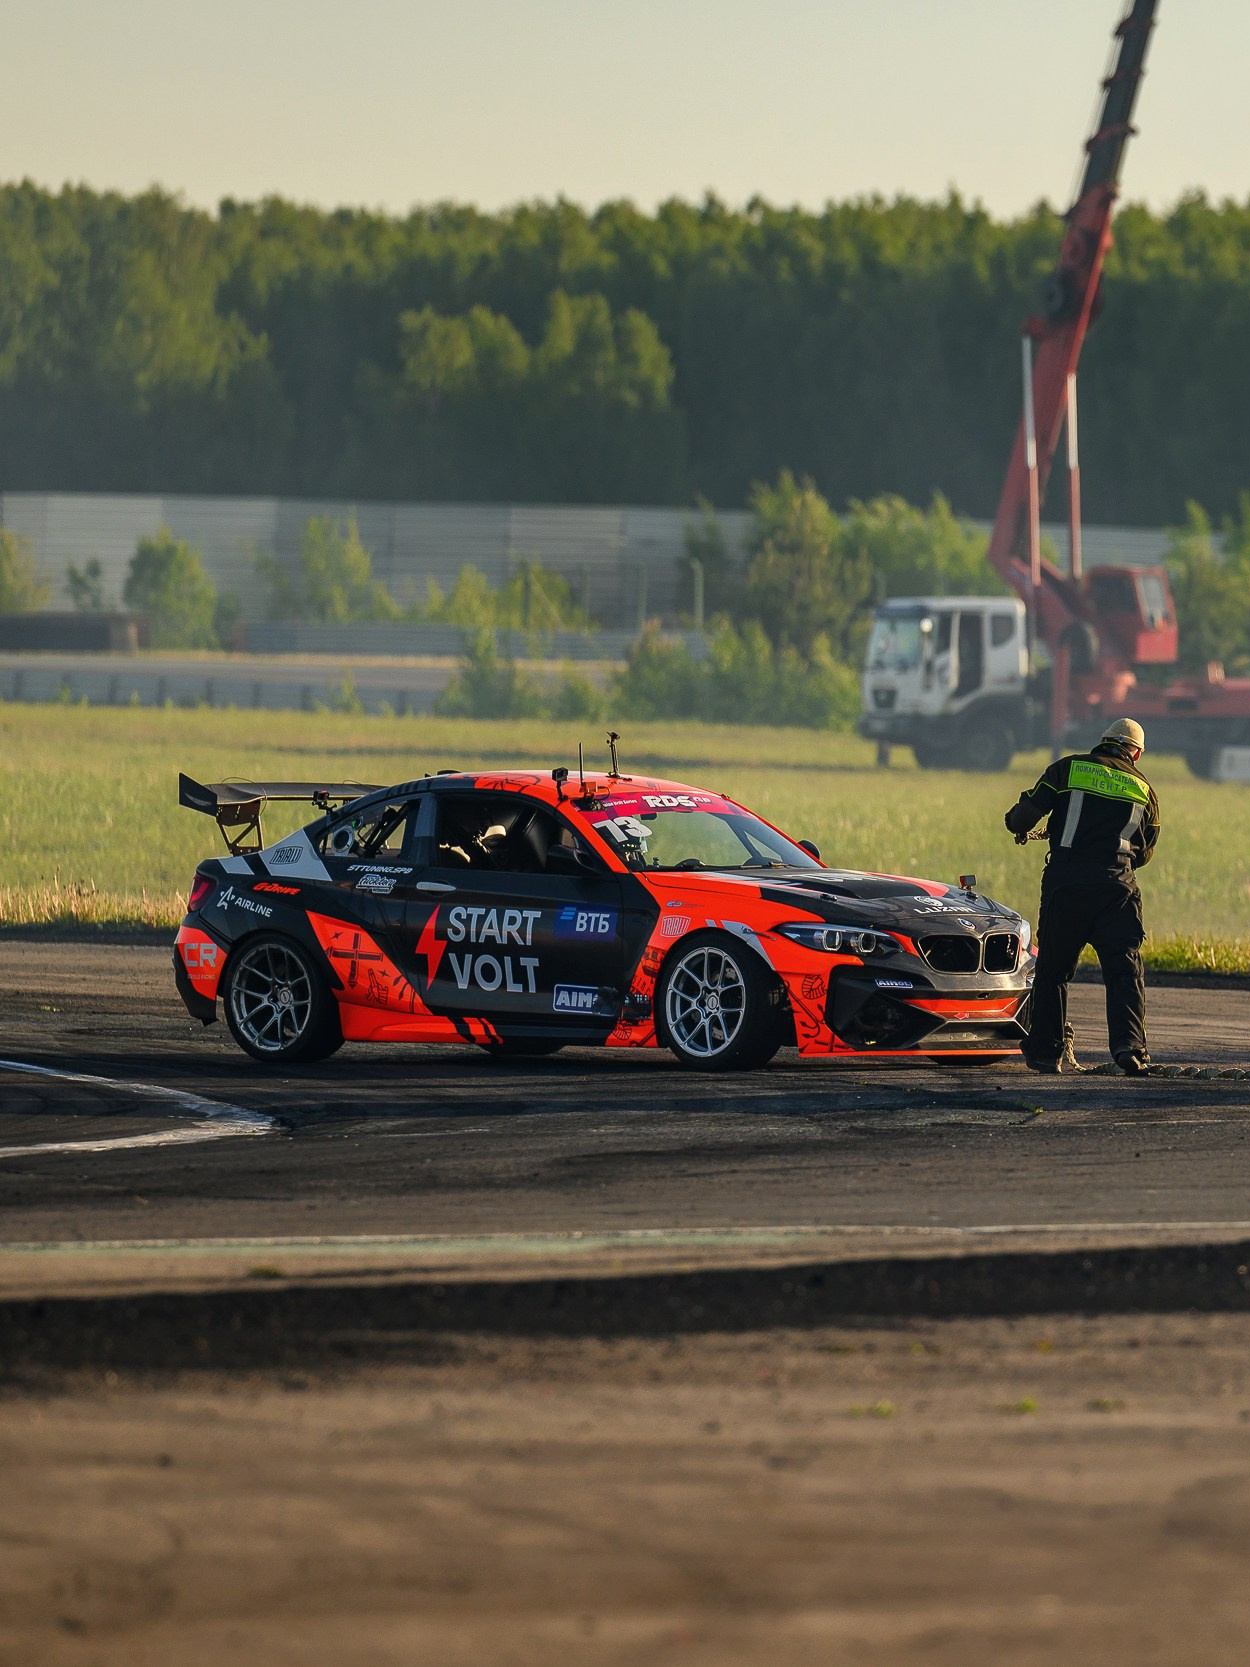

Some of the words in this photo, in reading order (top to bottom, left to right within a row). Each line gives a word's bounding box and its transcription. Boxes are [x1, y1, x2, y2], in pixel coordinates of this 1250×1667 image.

[1091, 778, 1128, 792] ЦЕНТР
[641, 795, 699, 808] RDS
[592, 816, 653, 843] 73
[234, 897, 273, 918] AIRLINE
[447, 906, 542, 946] START
[575, 912, 611, 933] ВТБ
[184, 943, 218, 968] CR
[448, 952, 540, 994] VOLT
[556, 989, 599, 1009] AIM
